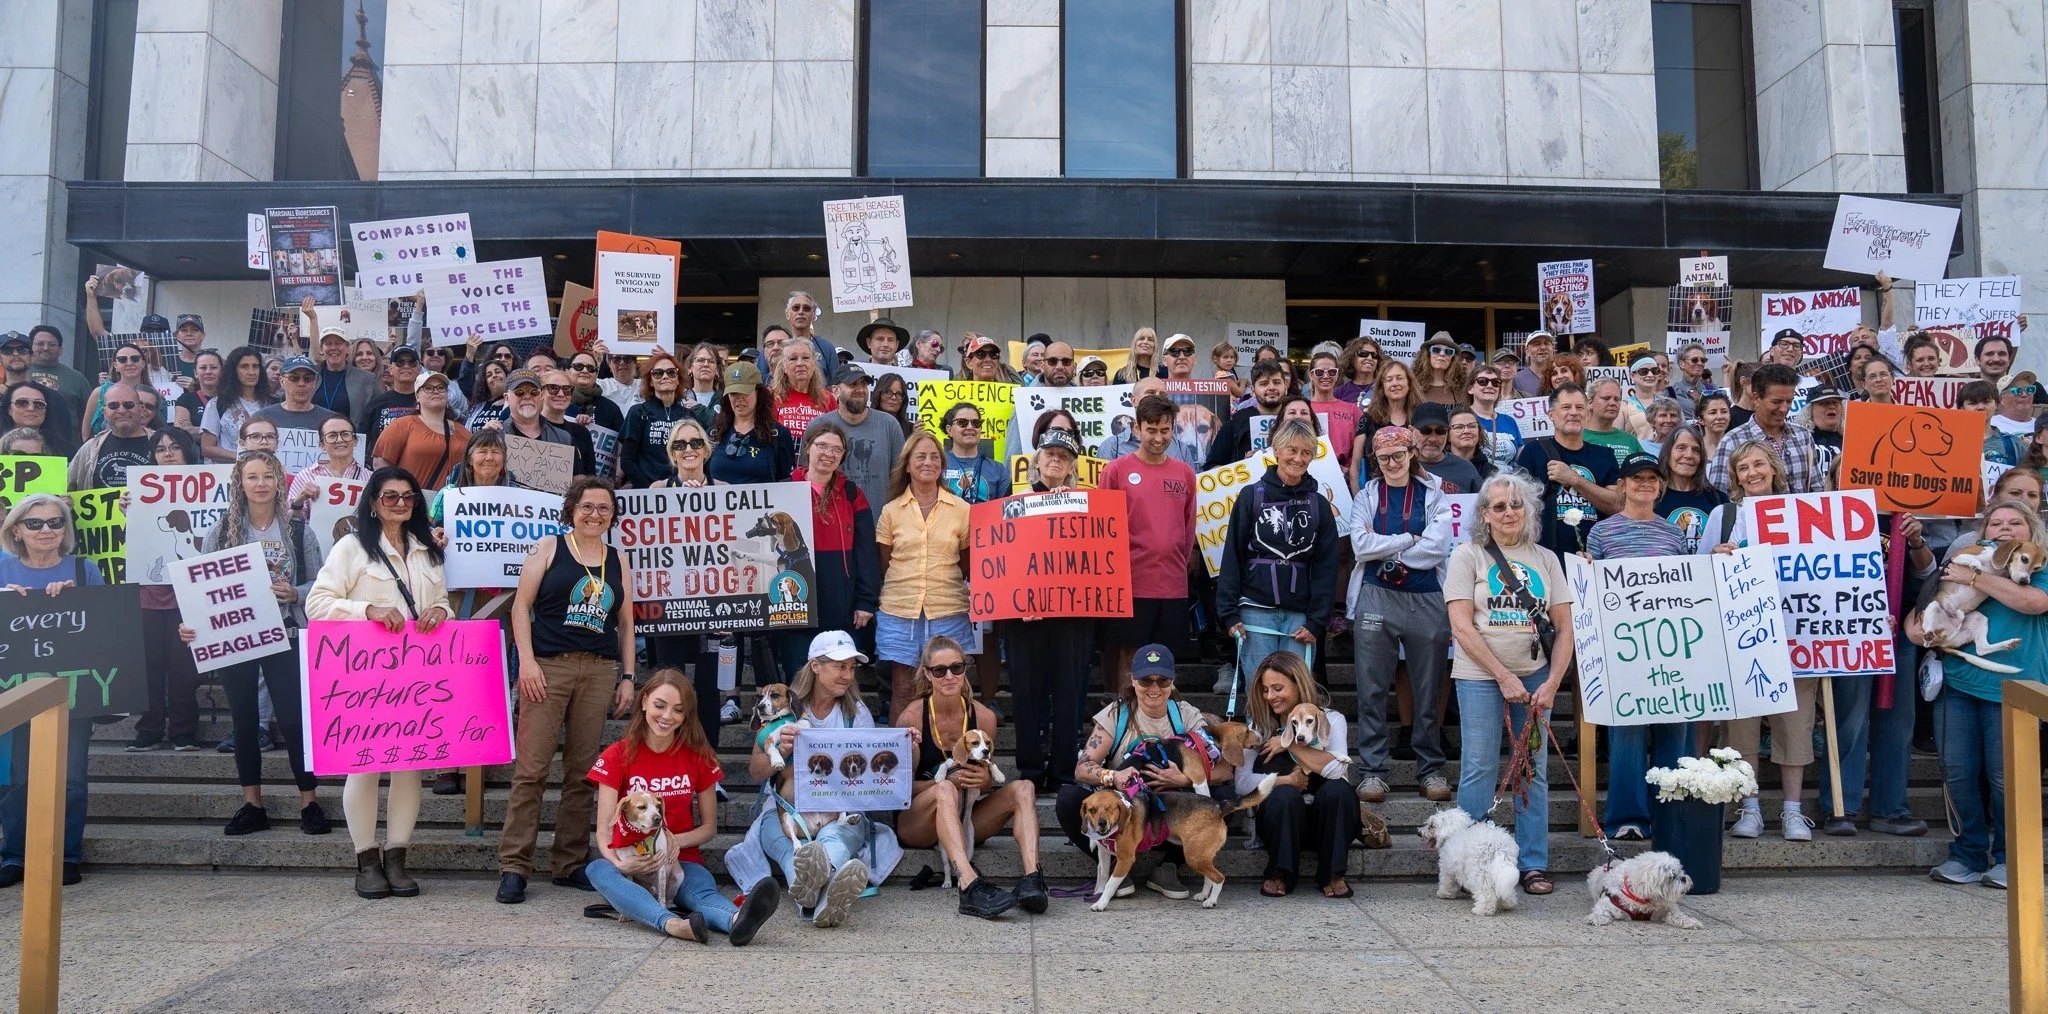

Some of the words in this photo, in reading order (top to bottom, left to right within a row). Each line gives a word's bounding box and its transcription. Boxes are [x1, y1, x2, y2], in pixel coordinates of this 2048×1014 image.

[826, 202, 847, 212] FREE
[849, 201, 864, 211] THE
[357, 220, 467, 242] COMPASSION
[398, 245, 441, 260] OVER
[448, 273, 467, 285] BE
[493, 267, 523, 280] THE
[1694, 262, 1715, 271] END
[296, 276, 311, 284] THEM
[375, 273, 424, 287] CRUE
[1545, 278, 1560, 287] END
[1561, 276, 1588, 285] ANIMAL
[1685, 272, 1724, 282] ANIMAL
[462, 284, 515, 298] VOICE
[621, 286, 654, 294] RIDGLAN
[873, 292, 897, 303] BEAGLE
[897, 291, 911, 301] LAB
[1549, 283, 1585, 293] TESTING
[1917, 282, 1969, 301] THEY
[1979, 280, 2022, 299] FEEL
[450, 303, 481, 316] FOR
[501, 300, 531, 313] THE
[1767, 296, 1807, 316] END
[1916, 306, 1951, 321] THEY
[1979, 308, 2017, 321] SUFFER
[441, 316, 538, 338] VOICELESS
[1237, 329, 1255, 337] Shut
[1257, 330, 1280, 338] Down
[1370, 327, 1391, 336] Shut
[1392, 328, 1417, 338] Down
[1241, 338, 1275, 346] Marshall
[1375, 338, 1411, 348] Marshall
[1676, 337, 1689, 345] I'm
[1706, 337, 1720, 345] Not
[1165, 381, 1192, 392] NIMAL
[1193, 381, 1228, 392] TESTING
[1061, 397, 1104, 413] FREE
[509, 437, 563, 458] SAVE
[130, 452, 150, 465] TRUST
[508, 452, 532, 465] MY
[534, 456, 571, 473] PAWS
[520, 469, 546, 479] WITH
[1850, 468, 1883, 486] Save
[1887, 471, 1909, 488] the
[1912, 474, 1947, 492] Dogs
[1951, 476, 1973, 494] MA
[140, 471, 216, 504] STOP
[455, 502, 534, 518] ANIMALS
[676, 492, 717, 513] YOU
[725, 489, 774, 511] CALL
[1025, 499, 1062, 509] LABORATORY
[1063, 497, 1087, 506] ANIMALS
[456, 519, 505, 539] NOT
[621, 514, 737, 546] SCIENCE
[1755, 495, 1876, 546] END
[976, 521, 1016, 549] END
[1047, 516, 1117, 541] TESTING
[456, 542, 473, 553] TO
[626, 546, 675, 570] THIS
[682, 543, 729, 567] WAS
[187, 553, 252, 583] FREE
[981, 555, 1006, 579] ON
[1027, 551, 1116, 576] ANIMALS
[1722, 553, 1753, 582] Let
[684, 565, 758, 596] DOG?
[1603, 561, 1693, 589] Marshall
[206, 582, 247, 605] THE
[1728, 574, 1765, 600] the
[567, 603, 608, 622] MARCH
[665, 600, 711, 610] ANIMAL
[667, 608, 714, 619] TESTING.
[768, 602, 808, 614] MARCH
[973, 592, 995, 616] GO
[1724, 596, 1777, 631] Beagles
[10, 610, 86, 634] every
[209, 607, 256, 630] MBR
[566, 614, 605, 628] ABOLISH
[657, 621, 707, 632] WITHOUT
[708, 618, 764, 629] SUFFERING
[769, 612, 808, 621] ABOLISH
[1575, 608, 1593, 630] STOP
[1737, 618, 1777, 650] GO!
[1795, 617, 1883, 636] FERRETS
[34, 638, 54, 658] is
[193, 626, 285, 662] BEAGLES
[1614, 616, 1704, 663] STOP
[314, 629, 465, 674] Marshall
[464, 652, 491, 667] bio
[1648, 664, 1684, 687] the
[320, 678, 454, 710] tortures
[323, 708, 444, 751] Animals
[458, 715, 496, 742] for
[650, 774, 691, 791] SPCA
[811, 789, 838, 797] names
[840, 789, 856, 797] not
[857, 788, 894, 796] numbers
